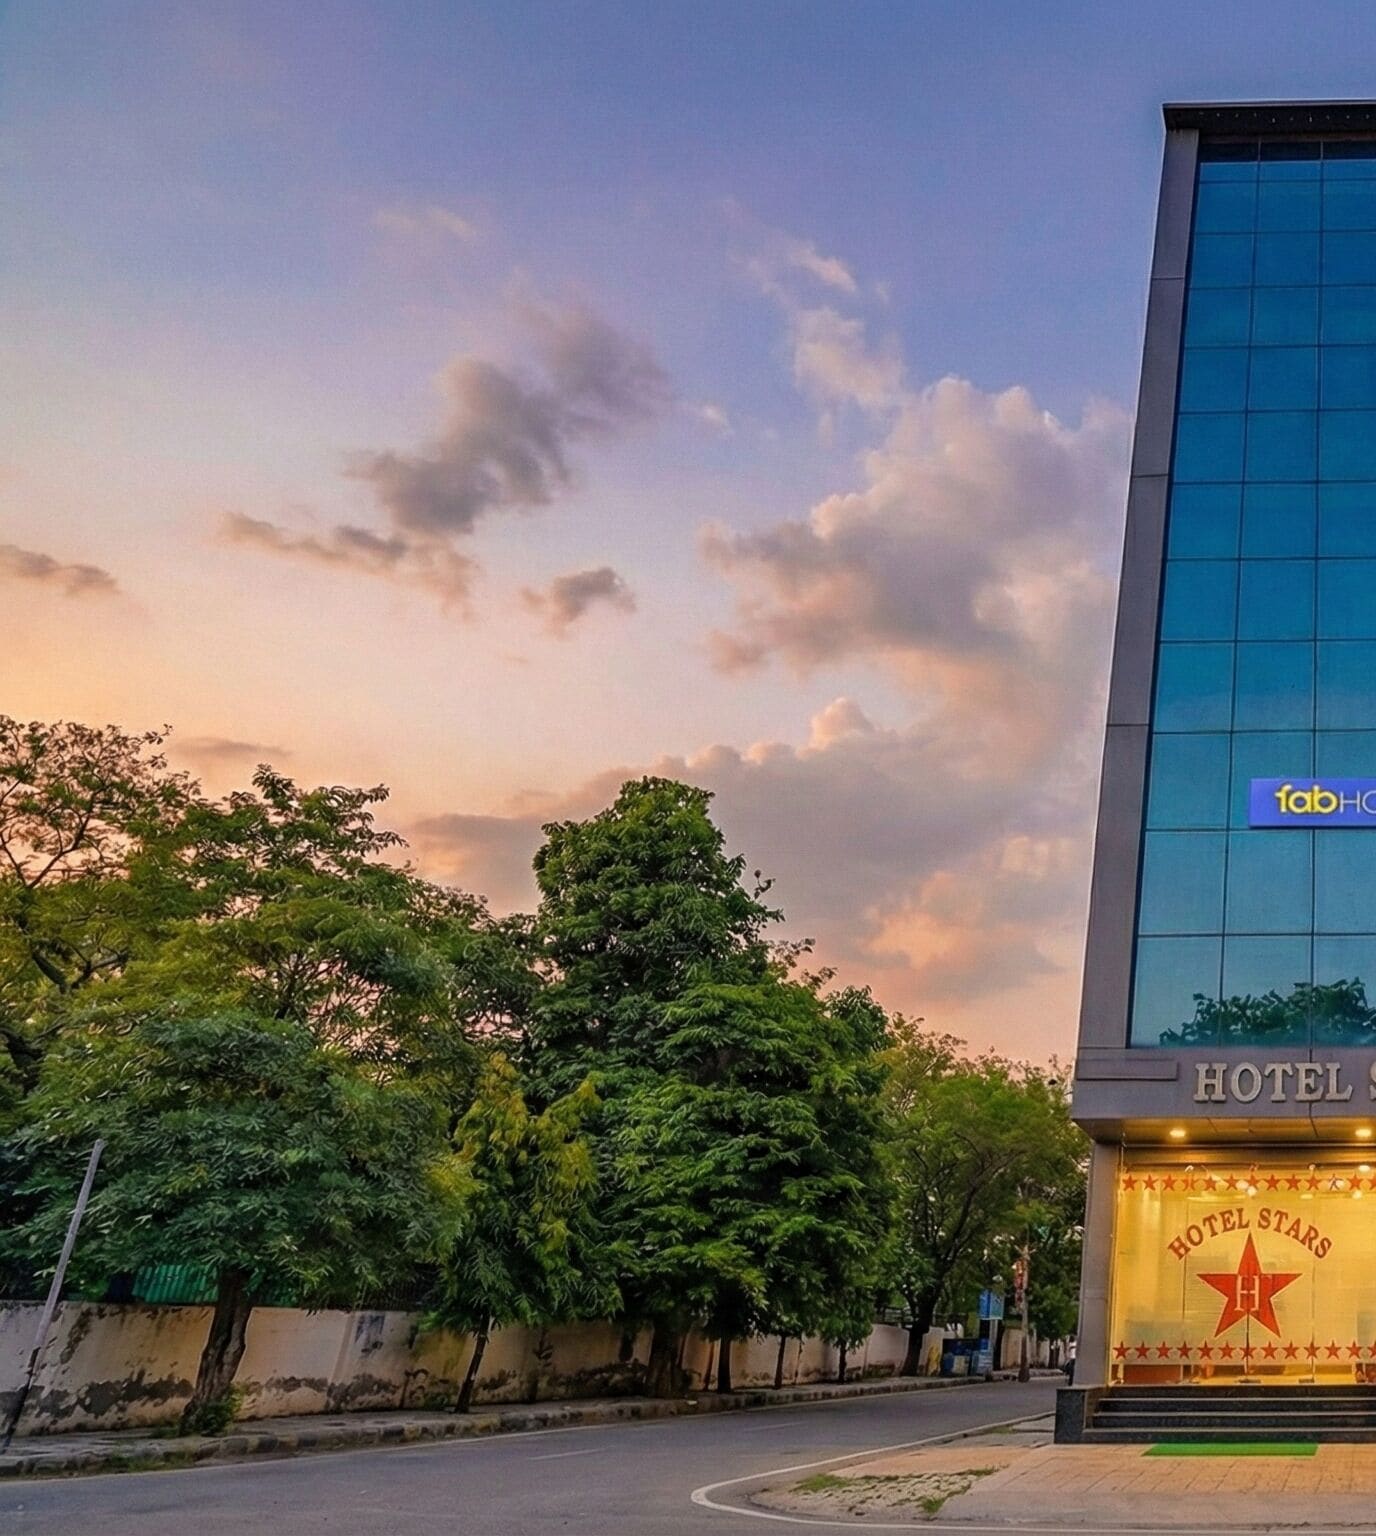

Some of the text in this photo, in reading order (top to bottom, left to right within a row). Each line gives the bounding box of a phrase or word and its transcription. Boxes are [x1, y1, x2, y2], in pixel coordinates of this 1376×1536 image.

[1193, 1062, 1353, 1102] HOTEL
[1168, 1207, 1333, 1260] HOTEL STARS
